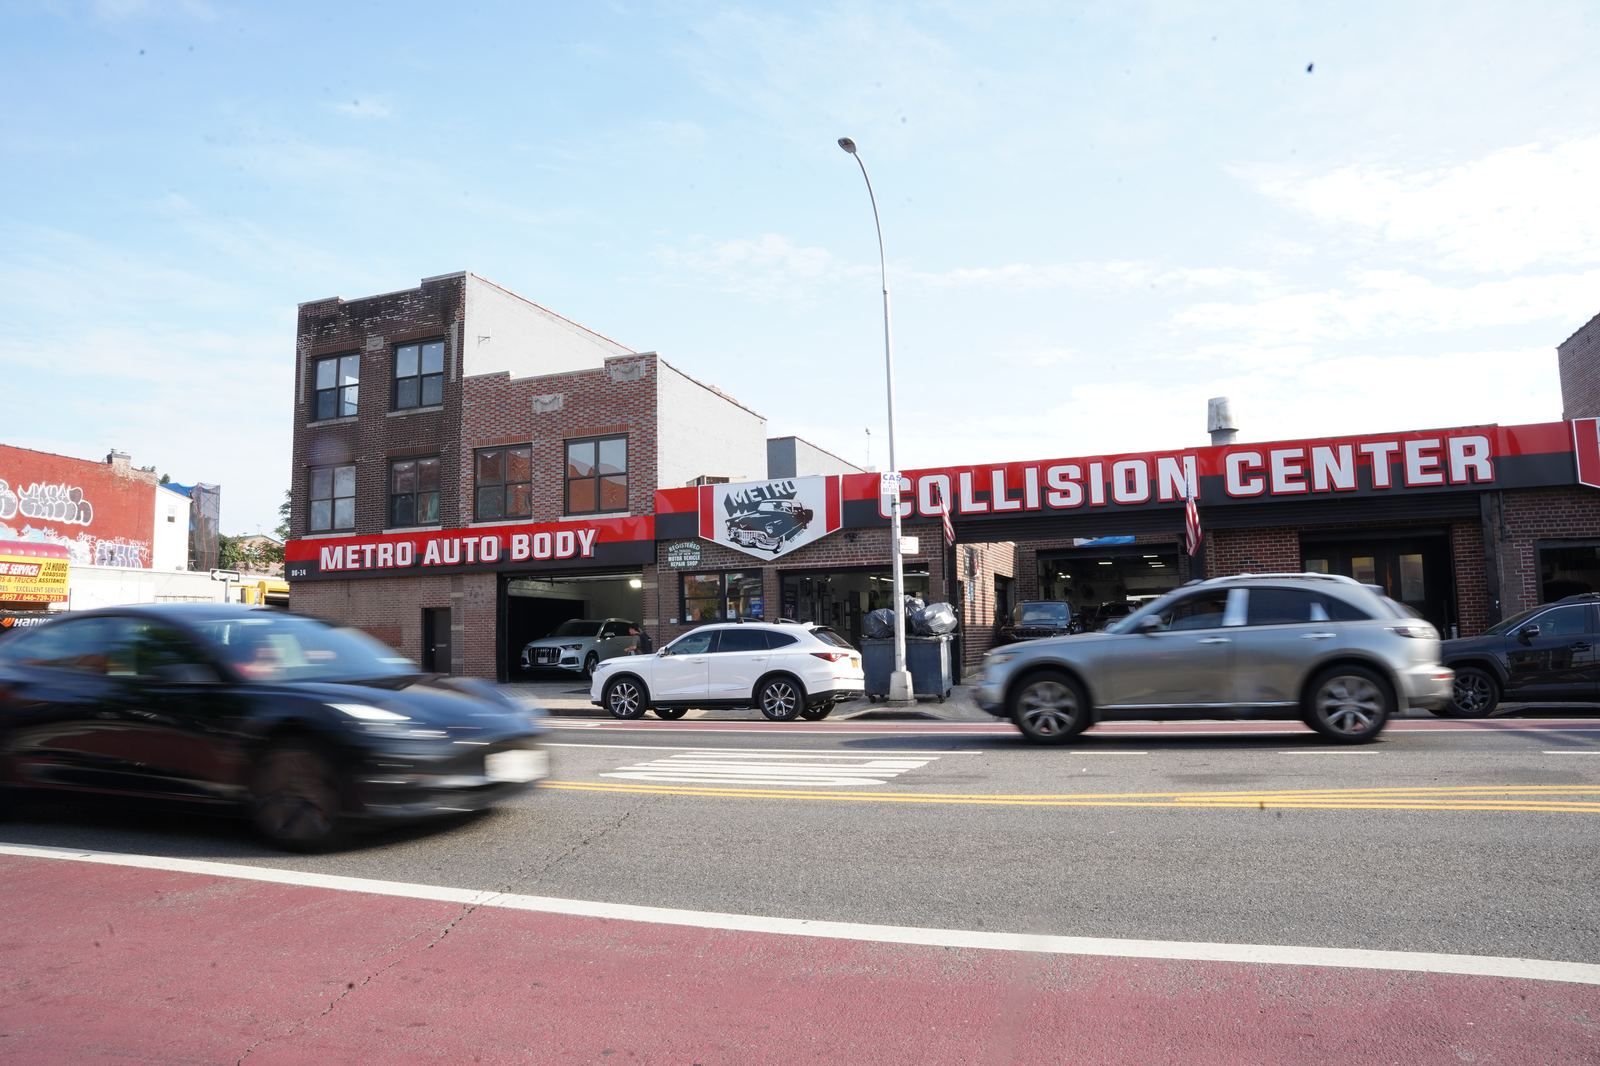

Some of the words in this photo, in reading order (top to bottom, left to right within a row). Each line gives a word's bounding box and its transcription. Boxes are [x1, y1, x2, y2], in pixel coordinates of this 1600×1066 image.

[880, 455, 1199, 519] COLLISION
[1225, 434, 1495, 497] CENTER
[727, 479, 797, 509] METRO
[319, 541, 413, 571] METRO
[423, 535, 499, 565] AUTO
[511, 529, 596, 561] BODY
[668, 542, 700, 552] REGISTERED
[9, 564, 38, 577] SERVICE
[44, 562, 52, 571] 24
[51, 563, 68, 572] HOURS
[599, 750, 941, 786] ONLY
